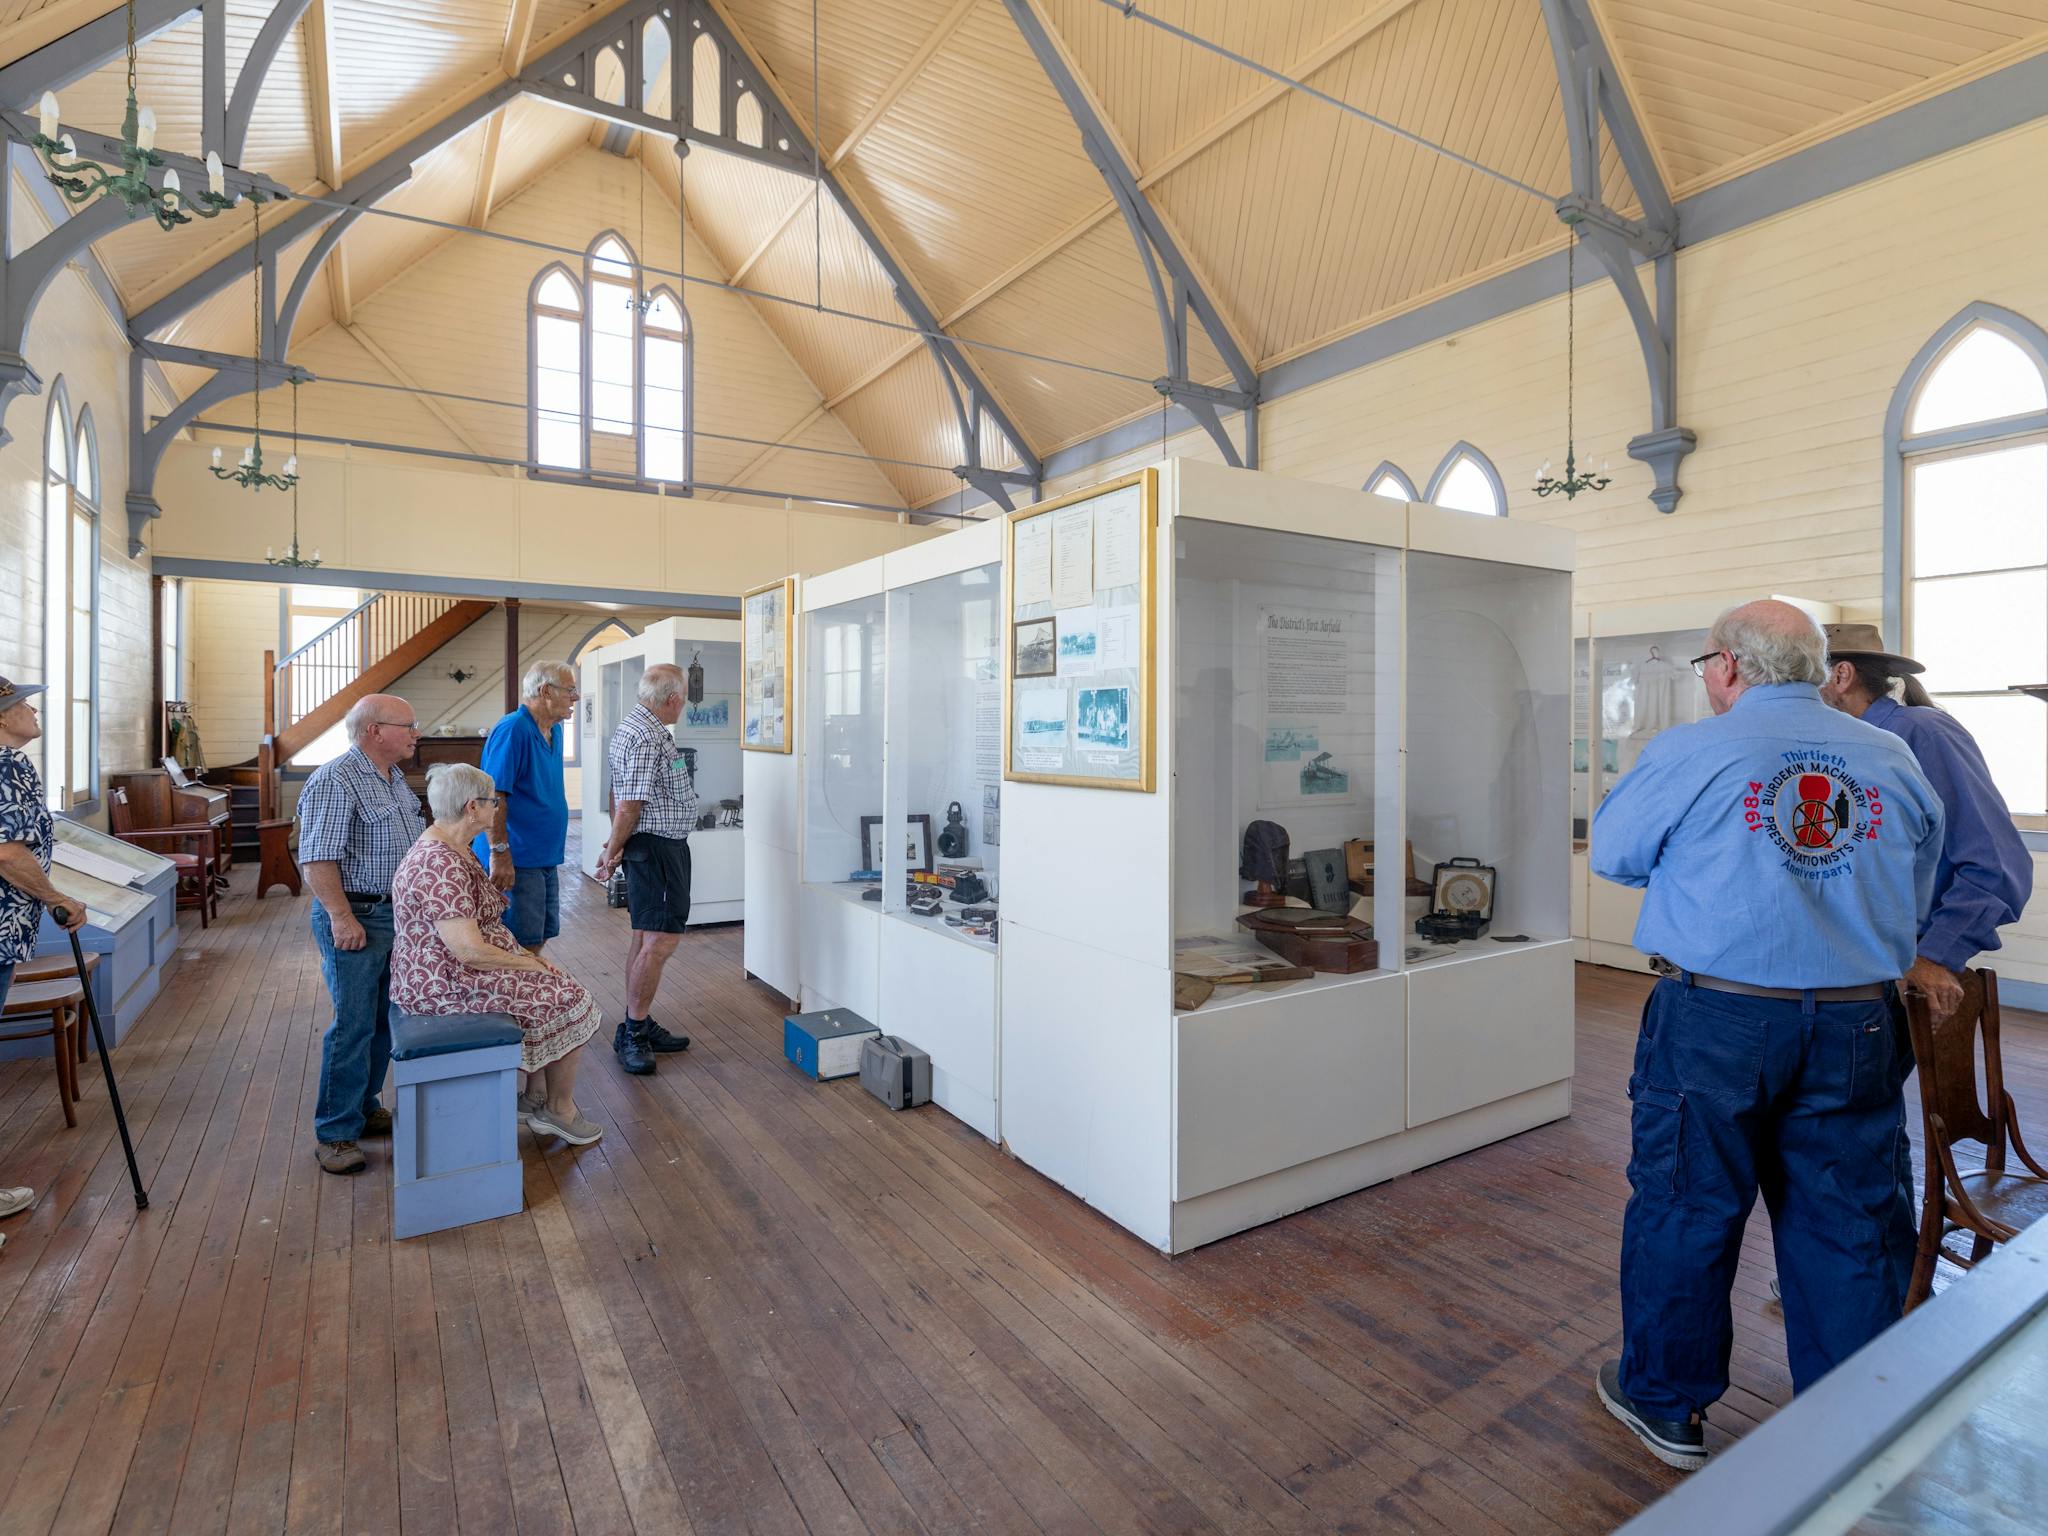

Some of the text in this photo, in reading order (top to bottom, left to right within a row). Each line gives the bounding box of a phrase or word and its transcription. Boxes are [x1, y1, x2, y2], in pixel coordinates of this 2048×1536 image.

[1781, 750, 1847, 768] Thirtieth
[1743, 781, 1764, 832] 1984
[1762, 762, 1868, 808] BURDEKIN MACHINERY
[1865, 786, 1883, 840] 2014
[1762, 816, 1869, 867] PRESERVATIONISTS INC.
[1781, 859, 1853, 880] Anniversary
